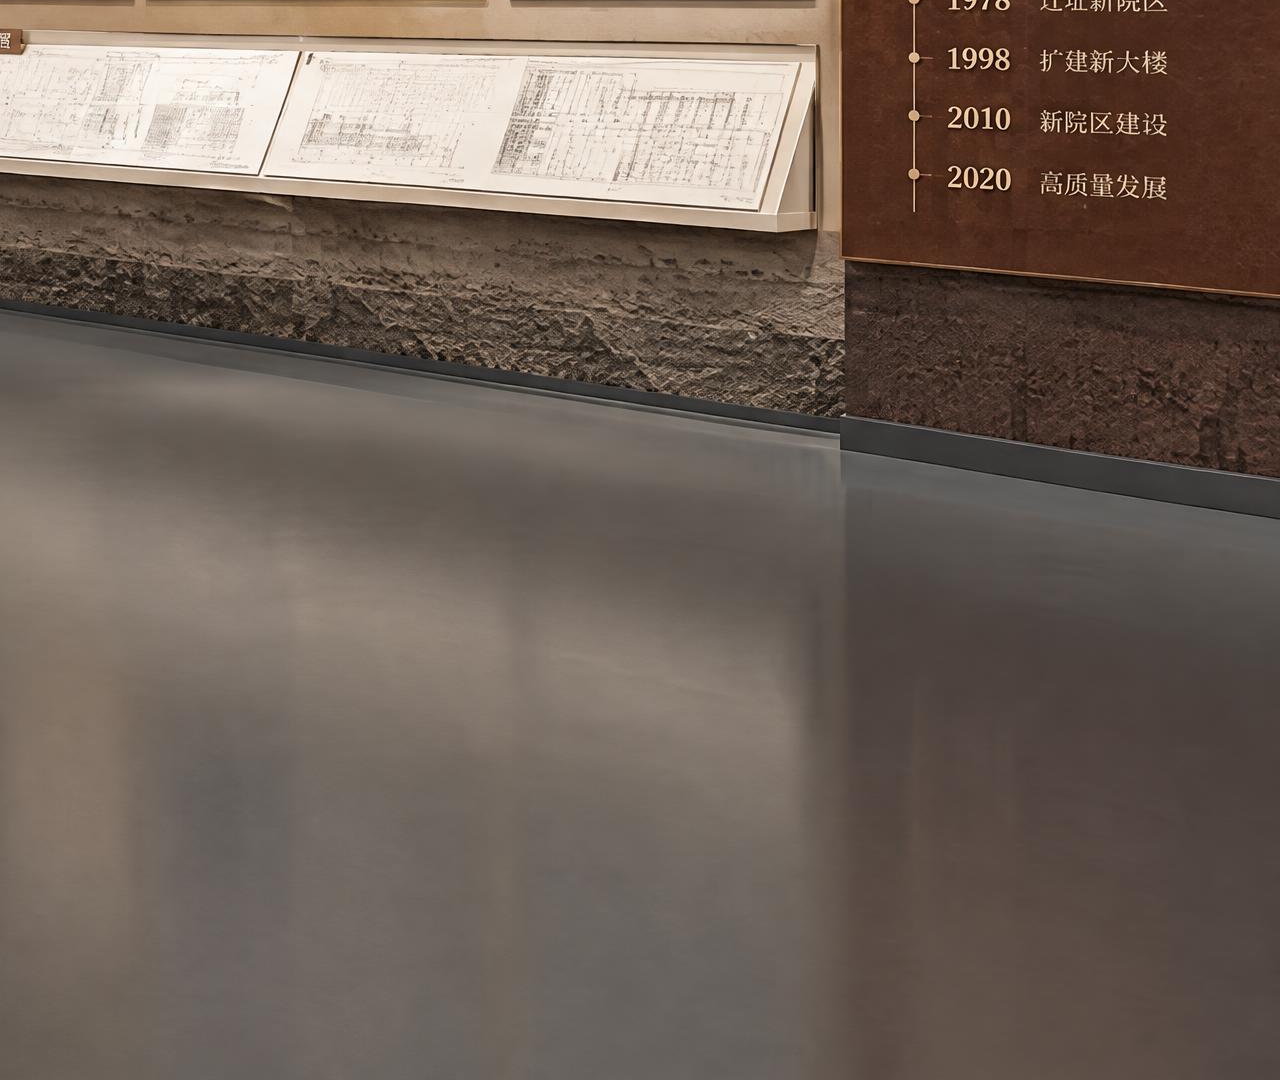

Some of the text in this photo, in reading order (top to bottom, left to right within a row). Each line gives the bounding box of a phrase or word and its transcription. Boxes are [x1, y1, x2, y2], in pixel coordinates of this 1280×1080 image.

[947, 48, 1168, 75] 1998 扩建新大楼
[947, 106, 1168, 137] 2010 新院区建设
[947, 166, 1168, 200] 2020 高质量发展
